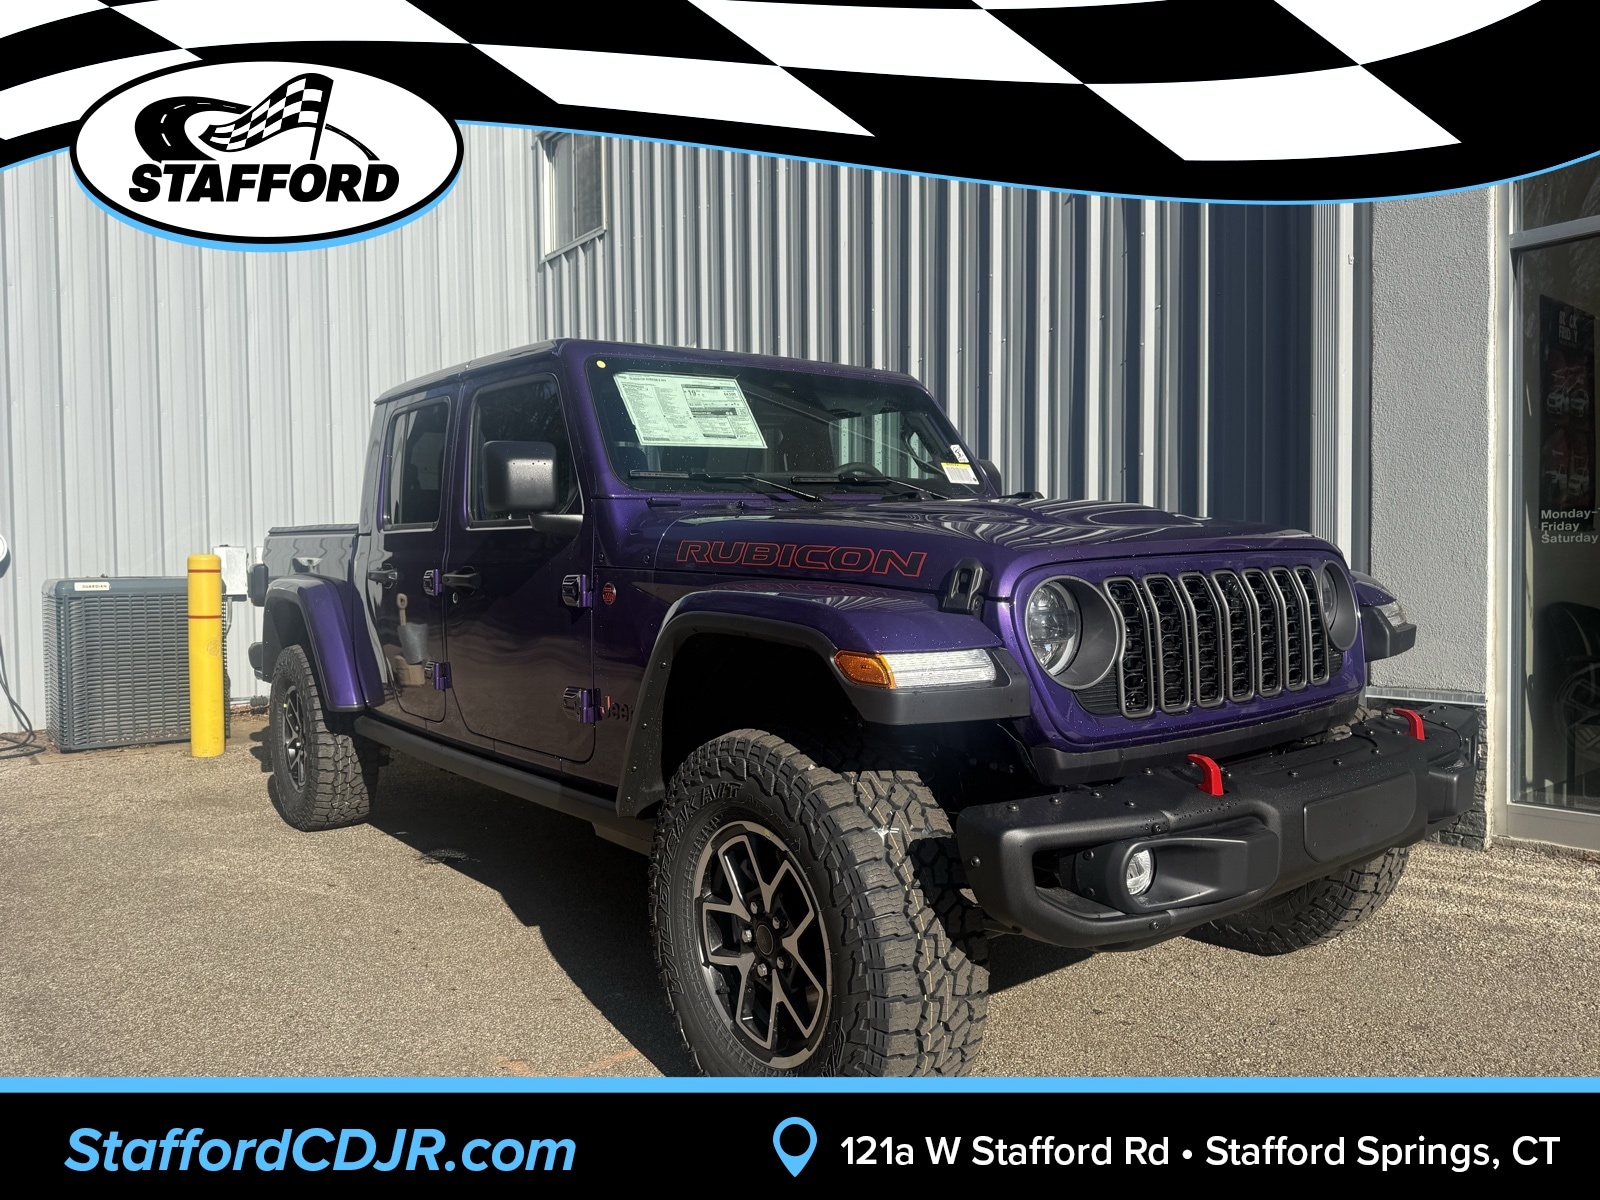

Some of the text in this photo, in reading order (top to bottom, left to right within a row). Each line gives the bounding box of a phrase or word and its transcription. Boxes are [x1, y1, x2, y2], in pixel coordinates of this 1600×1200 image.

[1541, 521, 1580, 532] Friday
[1541, 533, 1598, 544] Saturday
[676, 539, 928, 577] RUBICON
